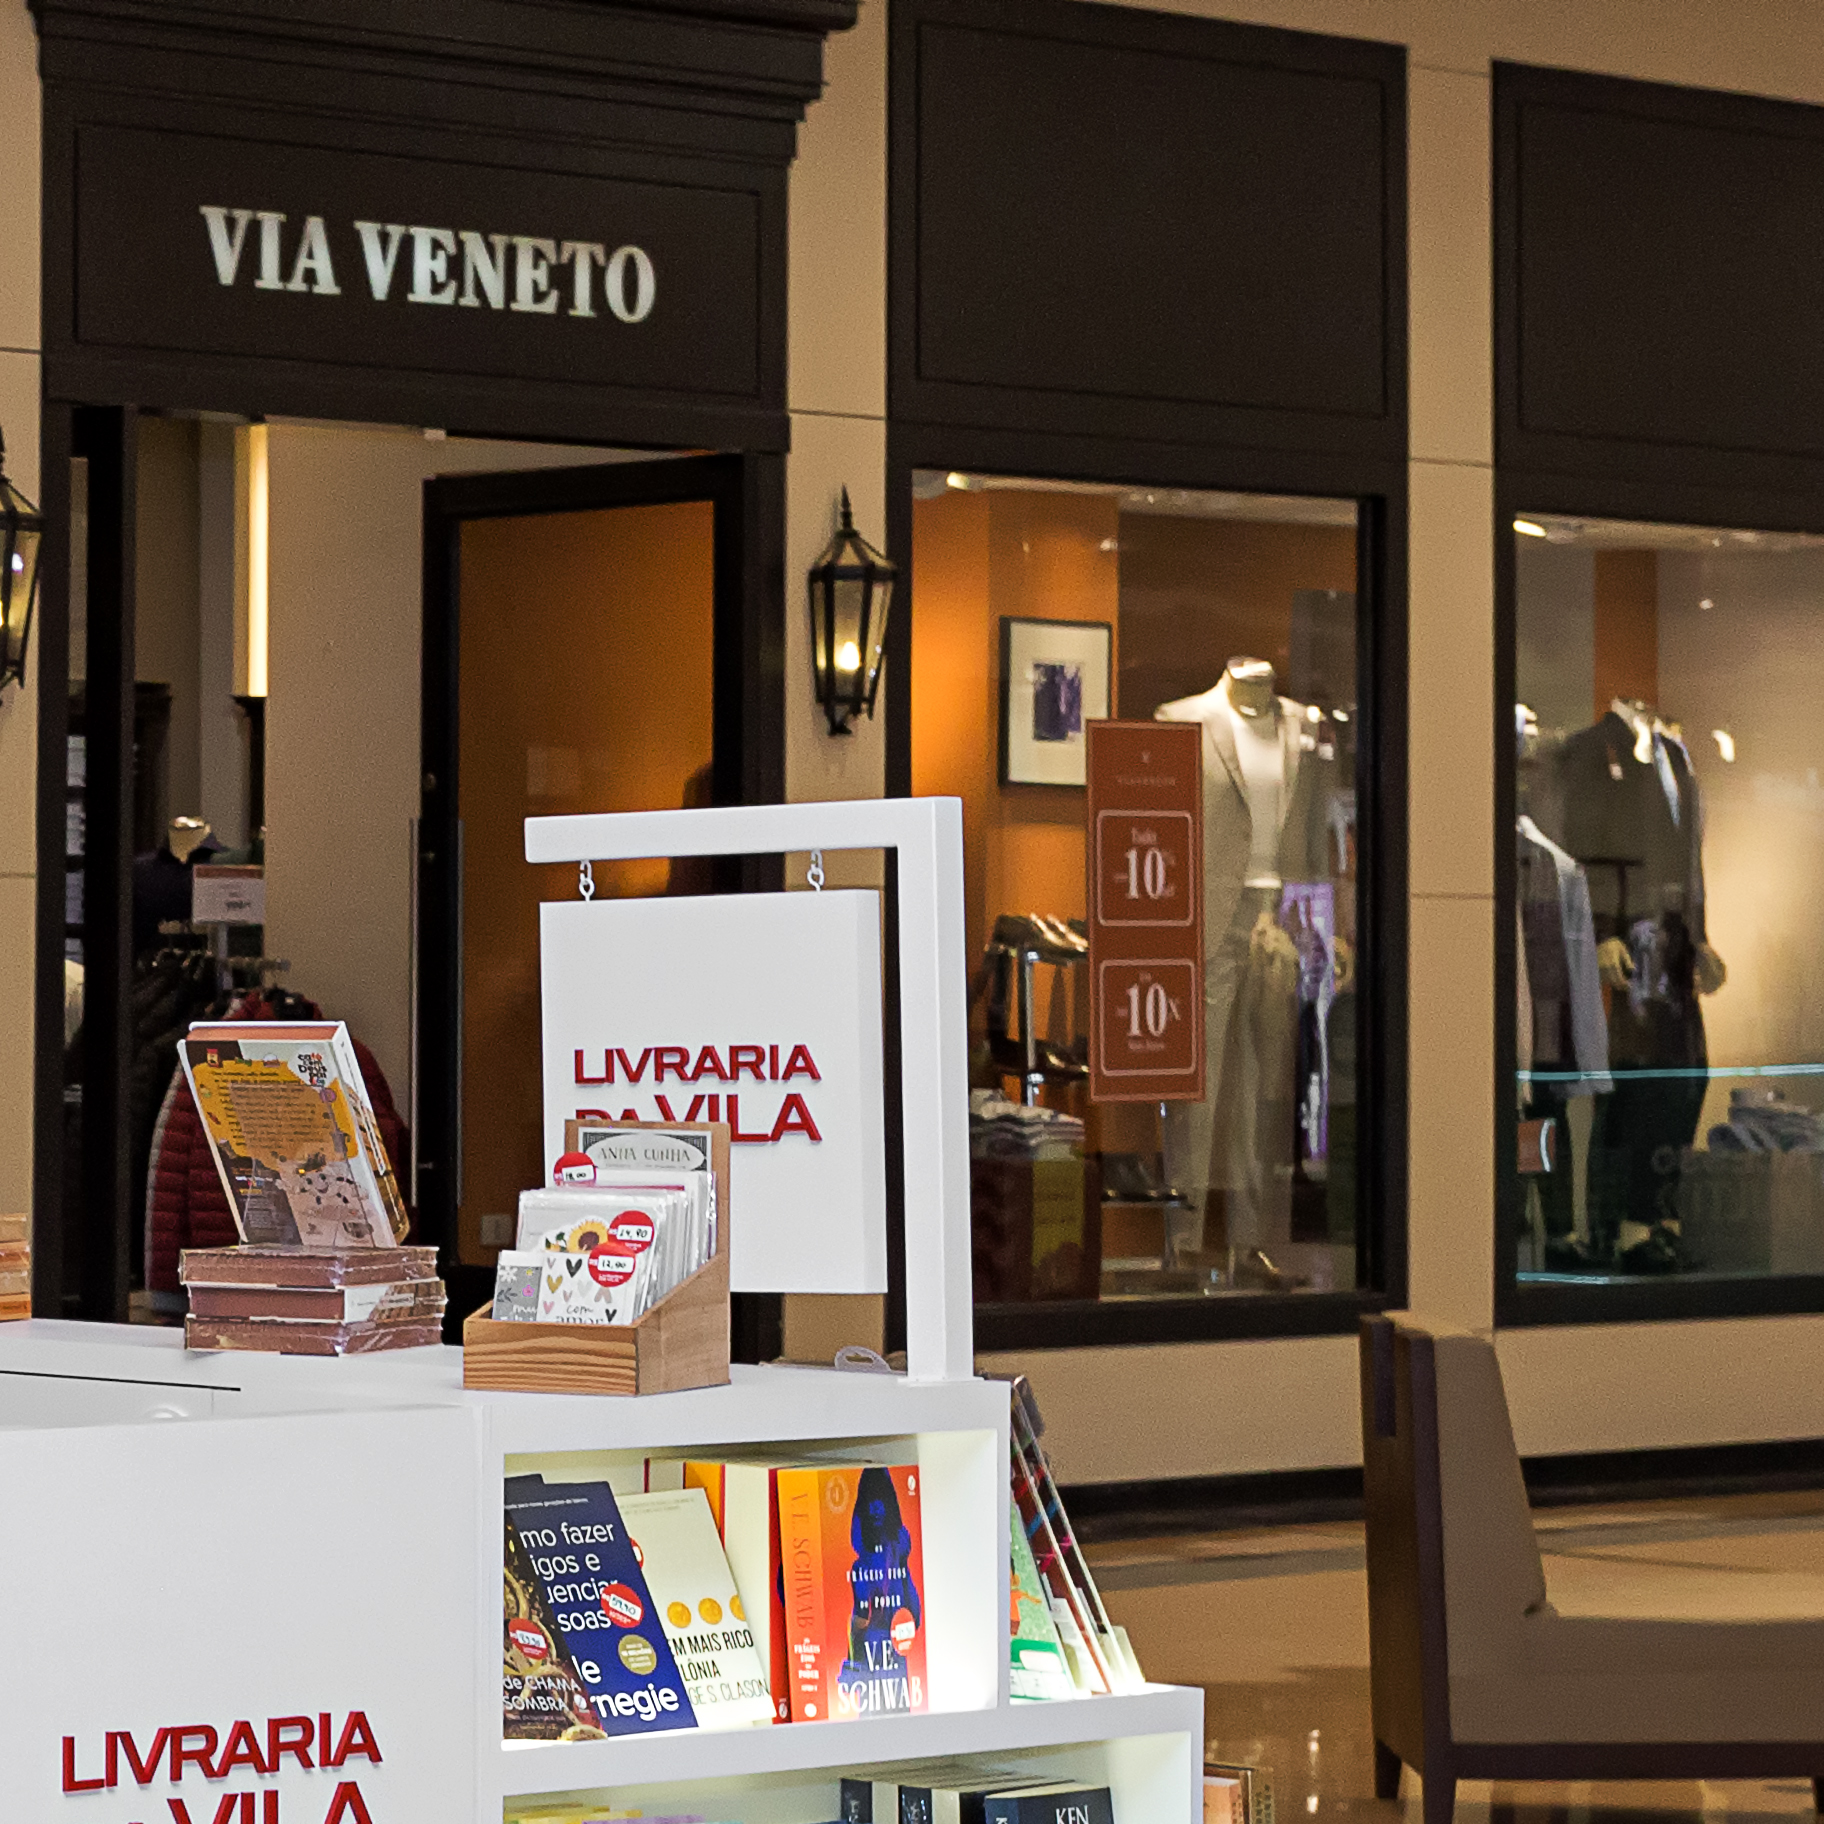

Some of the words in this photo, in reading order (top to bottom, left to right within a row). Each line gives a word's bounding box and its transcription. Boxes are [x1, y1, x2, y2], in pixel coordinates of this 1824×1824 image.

[199, 205, 340, 296] VIA
[354, 219, 657, 324] VENETO
[574, 1044, 822, 1084] LIVRARIA
[653, 1092, 823, 1143] VILA
[520, 1527, 557, 1548] mo
[560, 1521, 615, 1546] fazer
[530, 1554, 579, 1581] igos
[585, 1553, 601, 1571] e
[846, 1567, 884, 1583] FRÁGEIS
[887, 1566, 907, 1579] FIOS
[793, 1536, 814, 1629] SCHWAB
[860, 1600, 869, 1609] DO
[874, 1595, 902, 1608] PODER
[688, 1634, 722, 1654] MAIS
[722, 1629, 754, 1649] RICO
[864, 1640, 898, 1672] V.E.
[524, 1675, 582, 1692] CHAMA
[721, 1677, 770, 1700] CLASON
[837, 1675, 923, 1715] SCHWAB
[61, 1711, 383, 1792] LIVRARIA
